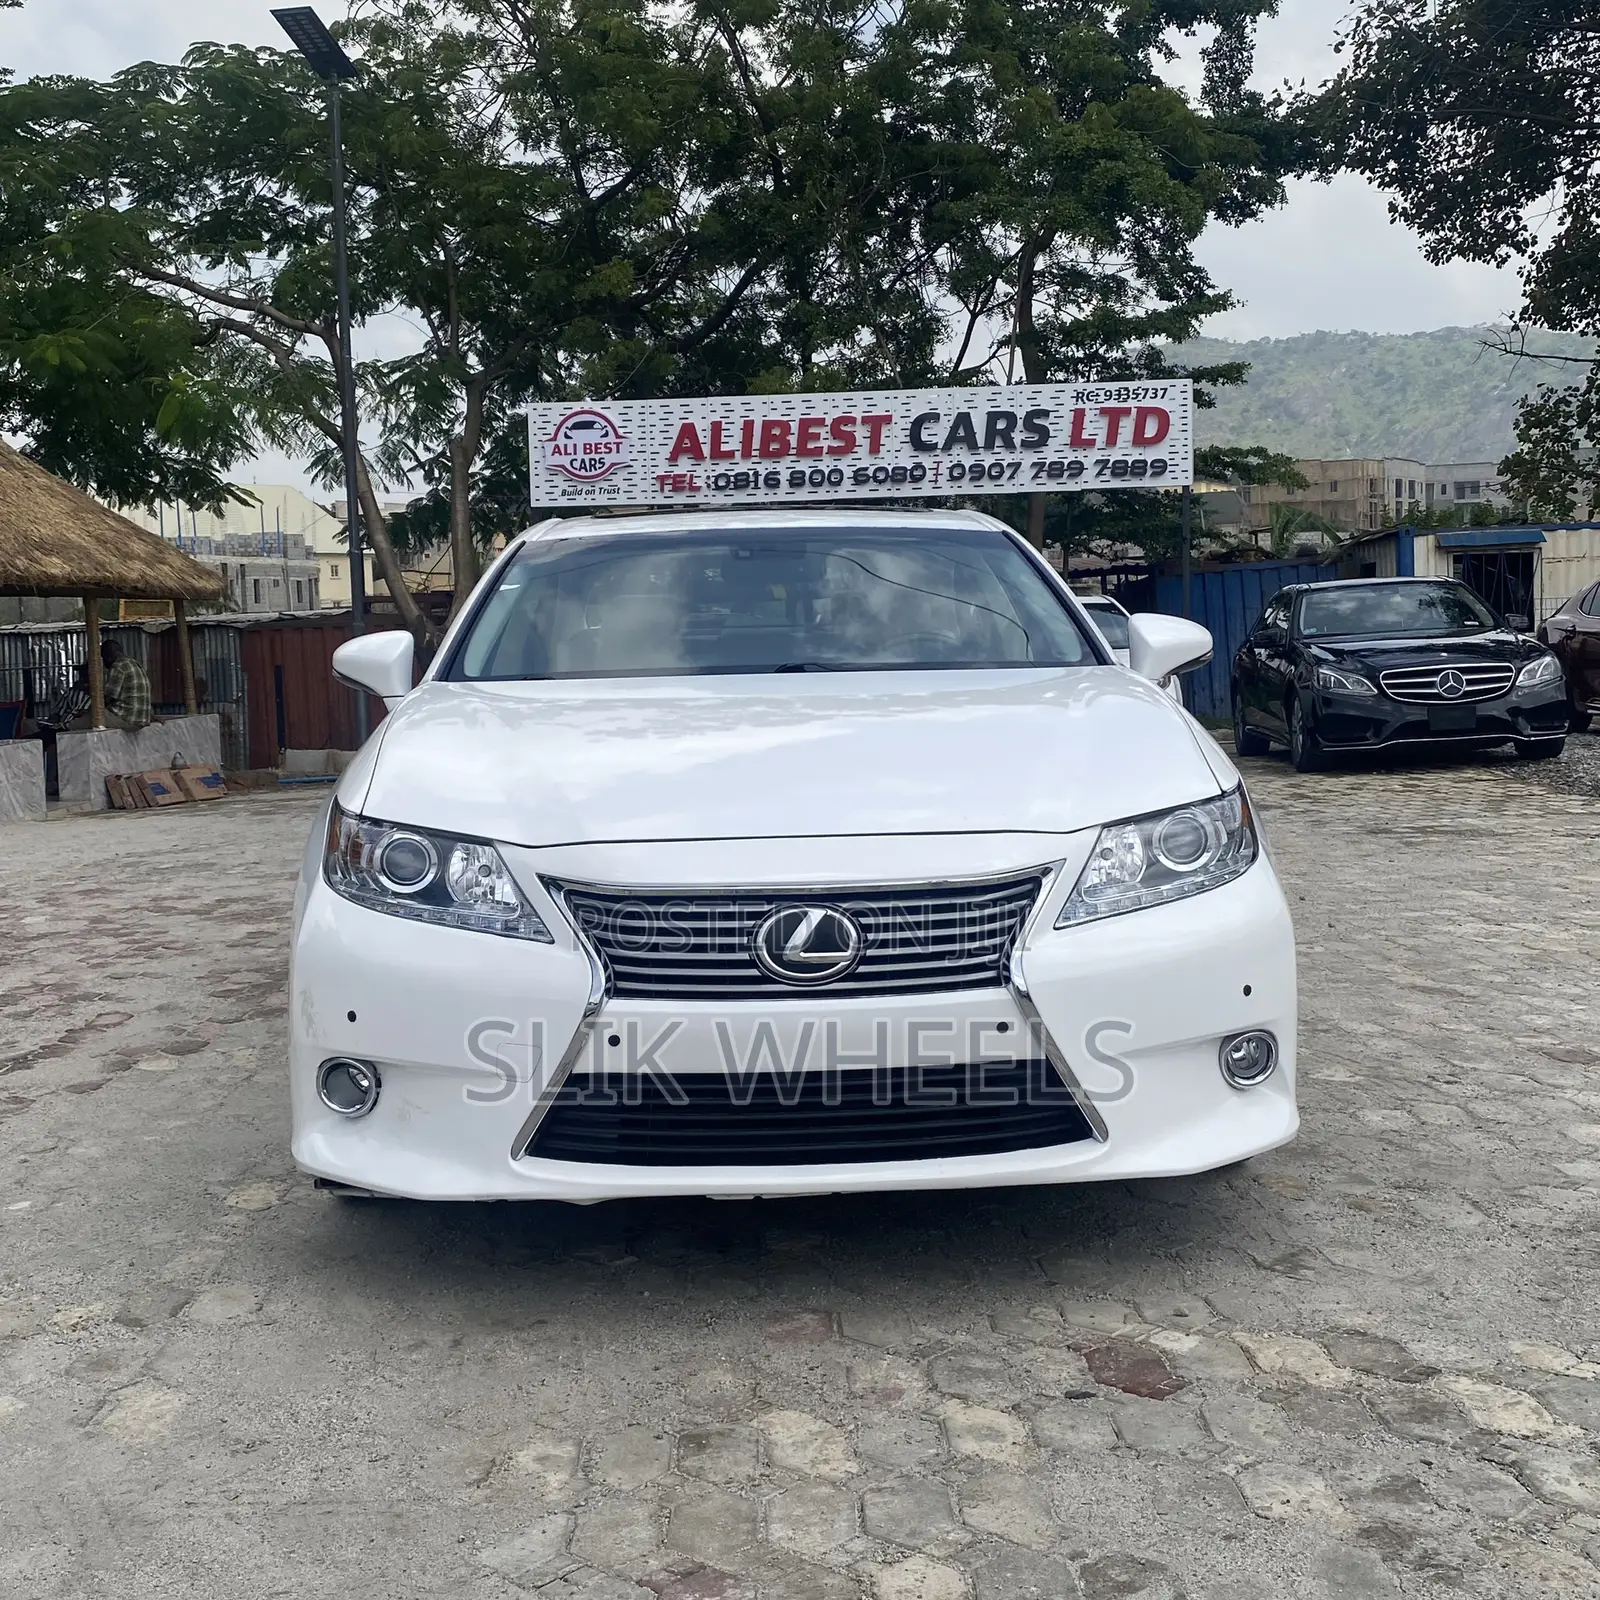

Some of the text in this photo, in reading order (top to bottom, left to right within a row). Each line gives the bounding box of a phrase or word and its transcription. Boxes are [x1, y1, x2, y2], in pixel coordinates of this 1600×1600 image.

[1103, 387, 1168, 401] 9335737
[668, 405, 1171, 463] ALIBEST CARS LTD
[551, 441, 623, 456] ALI BEST
[569, 457, 606, 472] CARS
[714, 471, 781, 491] 0816
[789, 468, 844, 489] 800
[852, 463, 927, 485] 6080
[949, 461, 1023, 482] 0907
[1030, 459, 1085, 480] 789
[1095, 457, 1168, 478] 7889
[560, 487, 583, 496] Build
